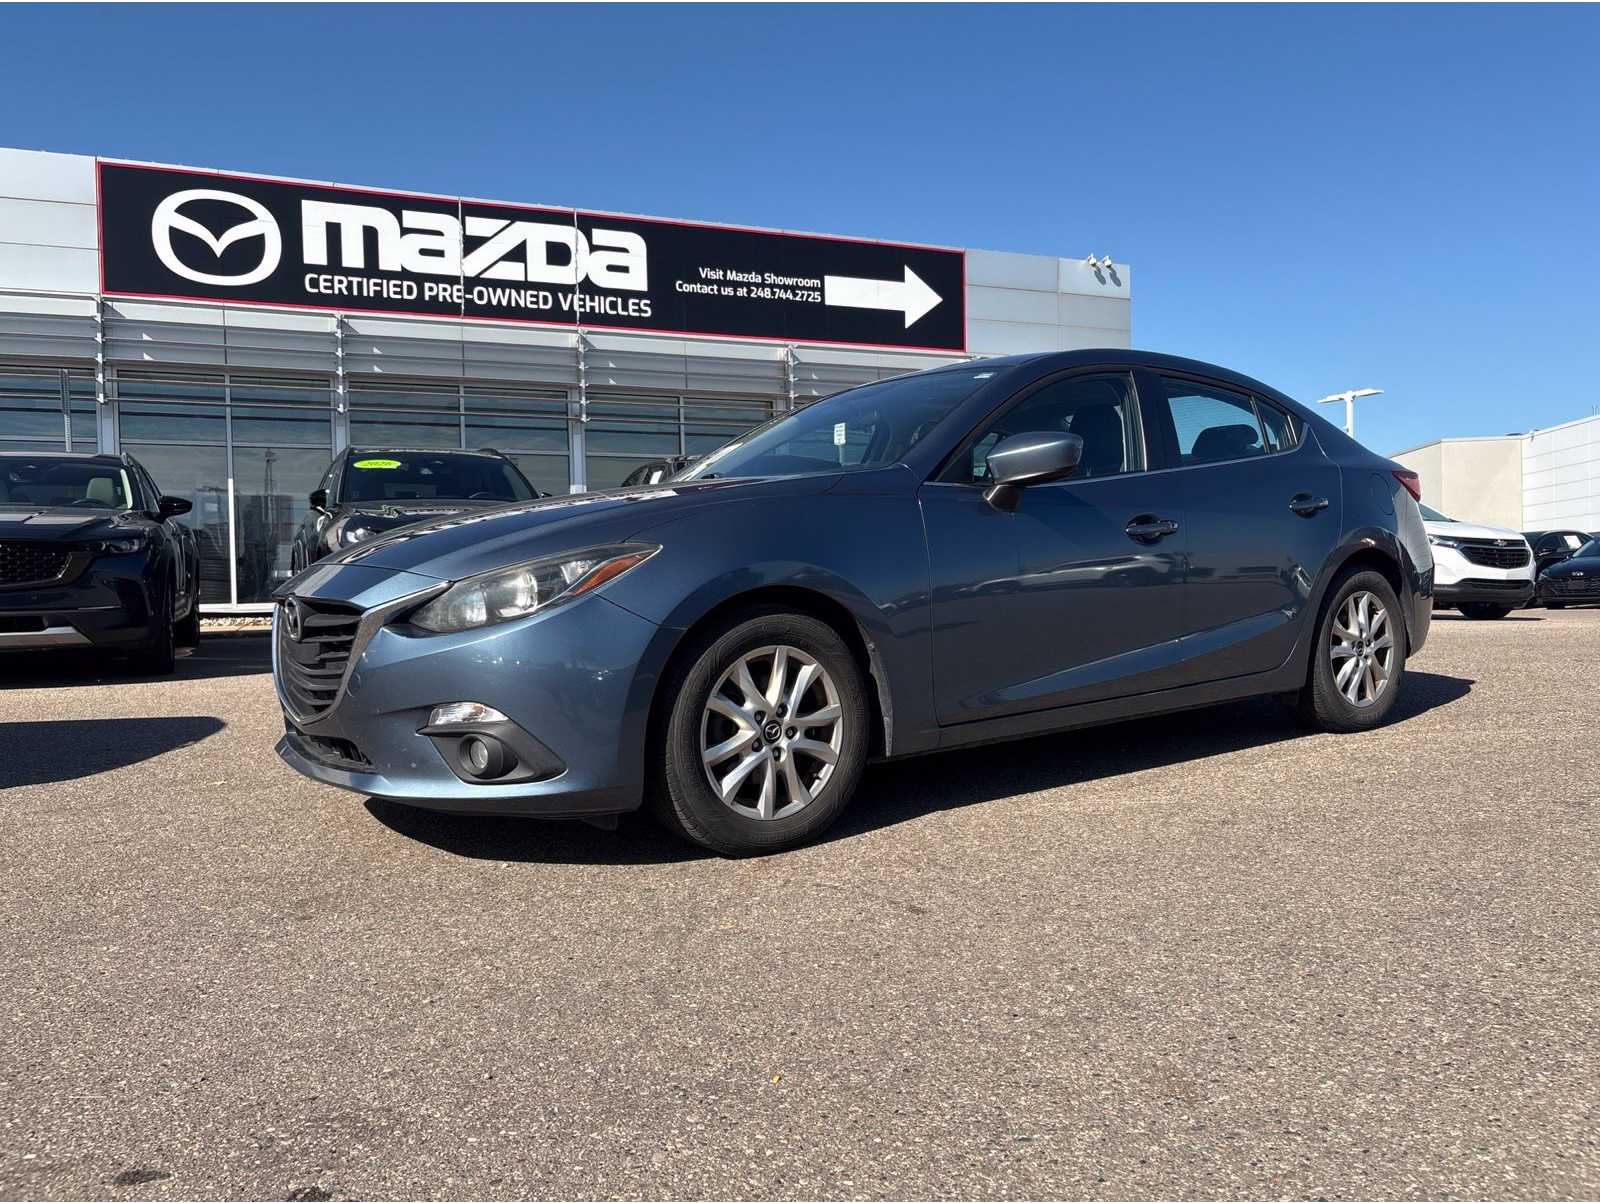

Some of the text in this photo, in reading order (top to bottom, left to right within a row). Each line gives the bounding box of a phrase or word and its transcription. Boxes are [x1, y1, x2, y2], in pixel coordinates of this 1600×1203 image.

[698, 267, 821, 288] Visit Mazda Showroom
[304, 273, 652, 318] CERTIFIED PRE-OWNED VEHICLES
[675, 280, 822, 303] Contact us at 248.744.2725
